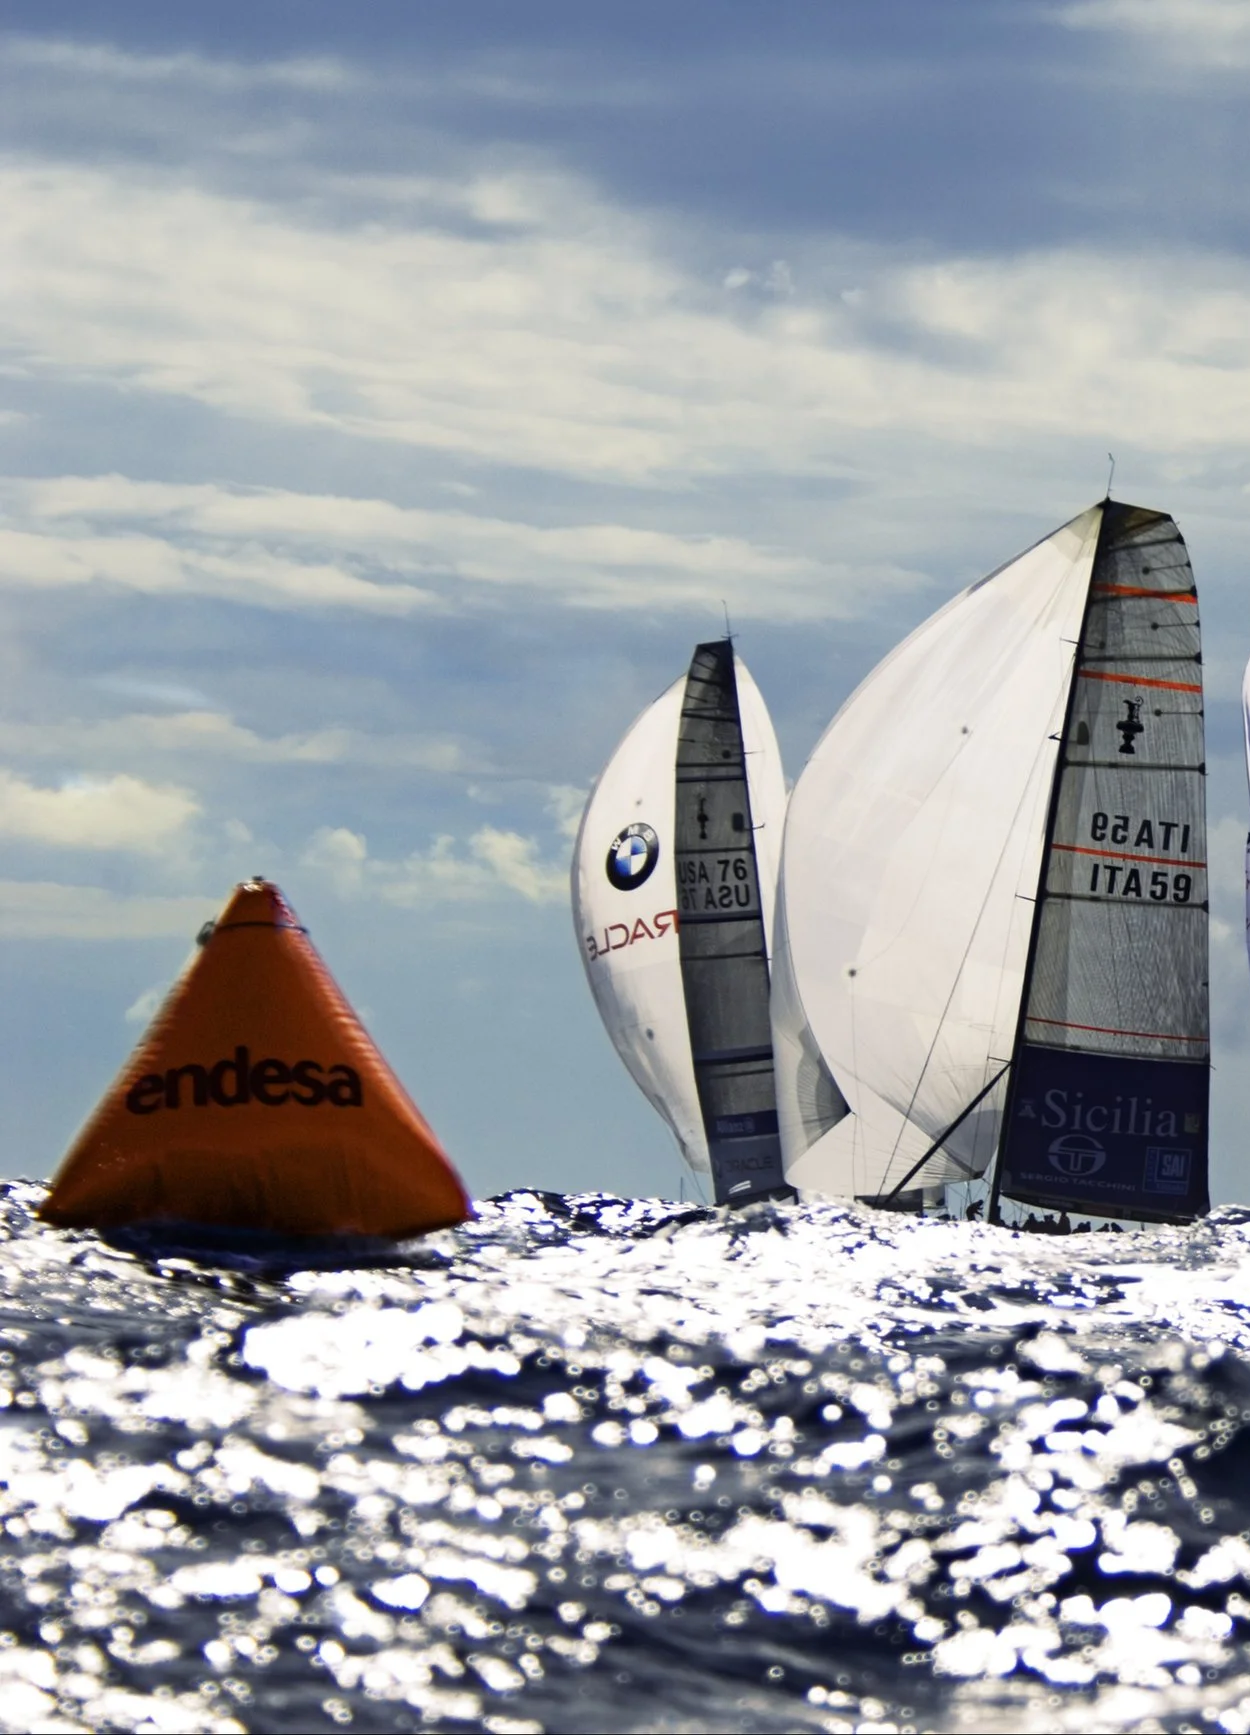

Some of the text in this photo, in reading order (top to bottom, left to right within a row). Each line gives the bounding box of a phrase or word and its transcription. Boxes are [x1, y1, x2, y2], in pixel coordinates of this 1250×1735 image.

[679, 858, 747, 884] USA 76
[125, 1045, 363, 1116] endesa
[1041, 1088, 1179, 1137] Sicilia
[1161, 1154, 1185, 1177] SAI
[1020, 1172, 1136, 1192] SERGIO TACCHINI
